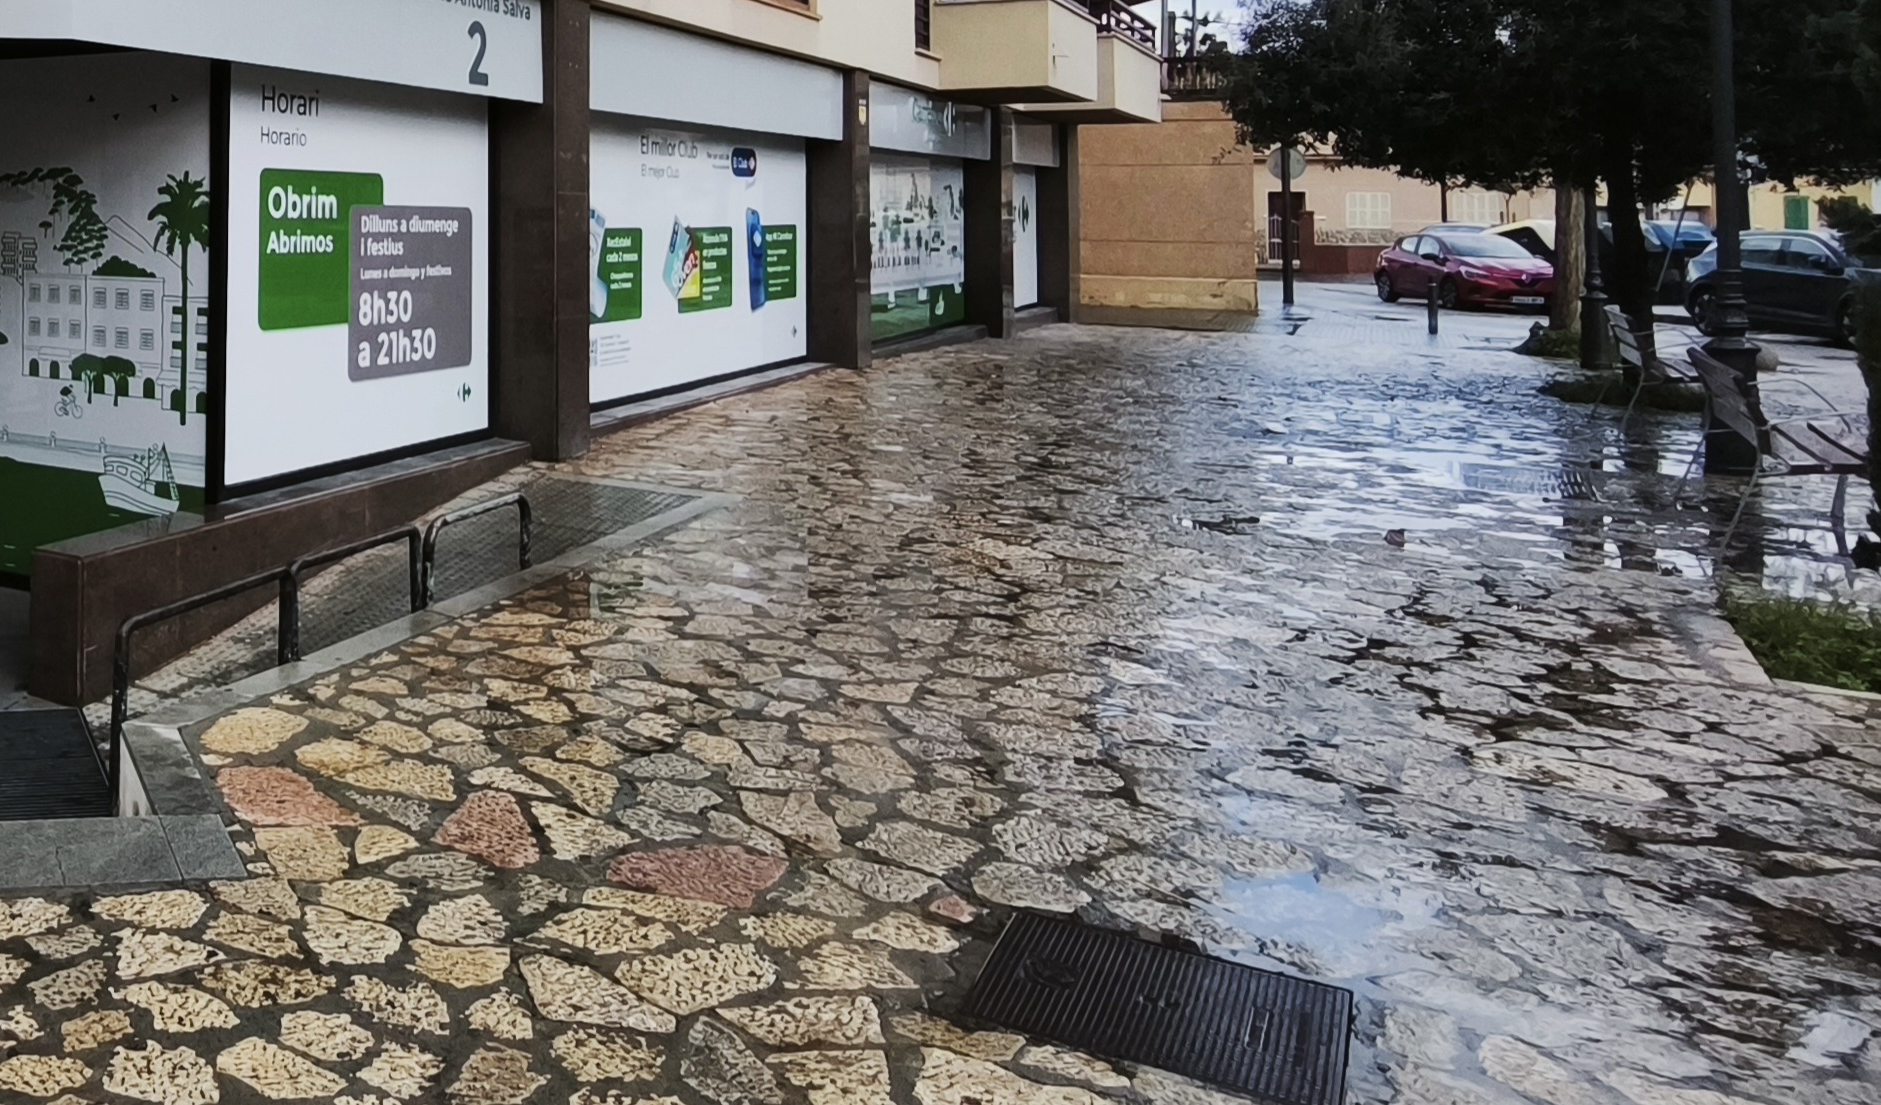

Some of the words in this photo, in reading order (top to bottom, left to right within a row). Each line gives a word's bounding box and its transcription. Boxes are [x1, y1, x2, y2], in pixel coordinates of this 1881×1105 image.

[467, 20, 489, 87] 2
[261, 83, 320, 117] Horari
[260, 125, 307, 147] Horario
[640, 135, 649, 155] El
[268, 185, 338, 221] Obrim
[360, 214, 398, 233] Dilluns
[400, 218, 407, 233] a
[408, 214, 459, 237] diumenge
[266, 230, 334, 255] Abrimos
[366, 236, 404, 256] festius
[358, 288, 413, 327] 8h30
[357, 339, 371, 369] a
[376, 327, 437, 366] 21h30
